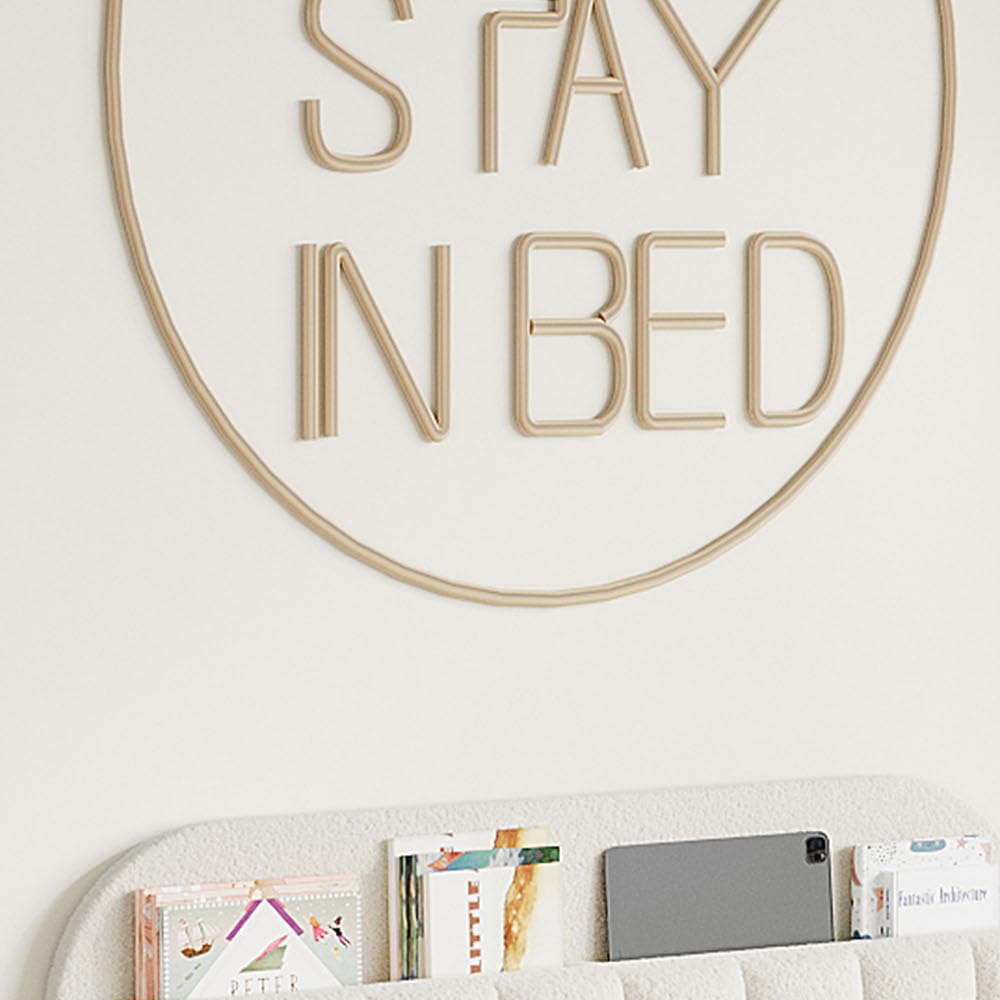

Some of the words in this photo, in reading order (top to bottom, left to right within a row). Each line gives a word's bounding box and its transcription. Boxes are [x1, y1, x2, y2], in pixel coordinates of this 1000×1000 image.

[294, 242, 452, 443] IN
[513, 232, 847, 438] BED
[468, 881, 482, 974] LITTLE
[231, 973, 299, 996] PETER
